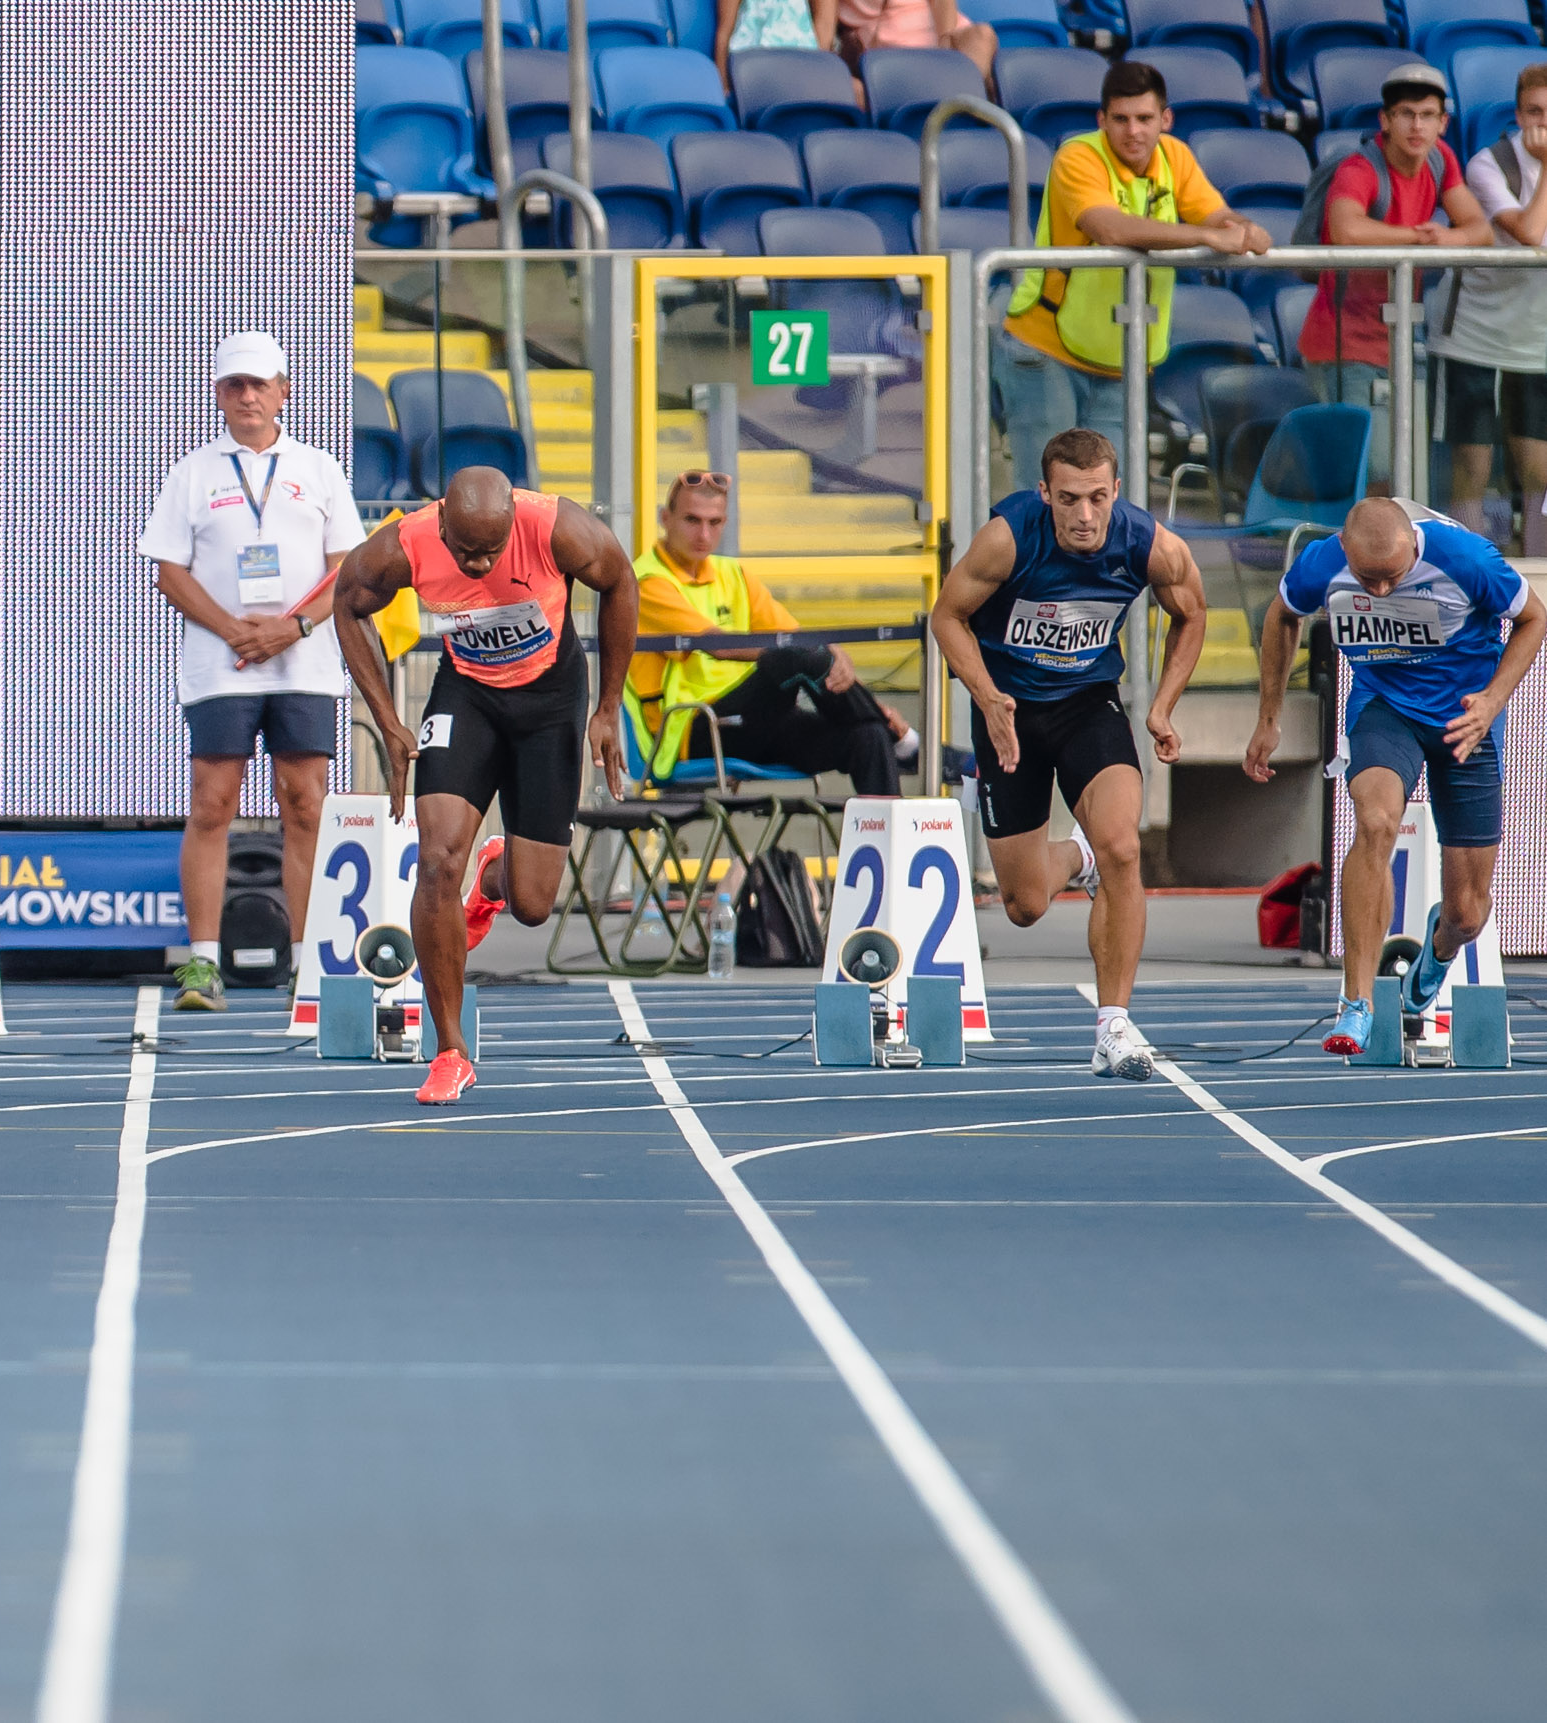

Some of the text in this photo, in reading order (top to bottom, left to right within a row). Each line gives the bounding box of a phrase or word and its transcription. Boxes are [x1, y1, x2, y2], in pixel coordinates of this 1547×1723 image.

[768, 322, 814, 376] 27
[1011, 618, 1110, 651] OLSZEWSKI
[1336, 615, 1440, 645] HAMPEL
[421, 721, 435, 745] 3
[343, 813, 375, 828] polanik
[860, 818, 886, 833] polanik
[921, 818, 953, 833] polanik
[1397, 822, 1418, 835] anik
[318, 840, 371, 975] 3
[908, 845, 965, 986] 2
